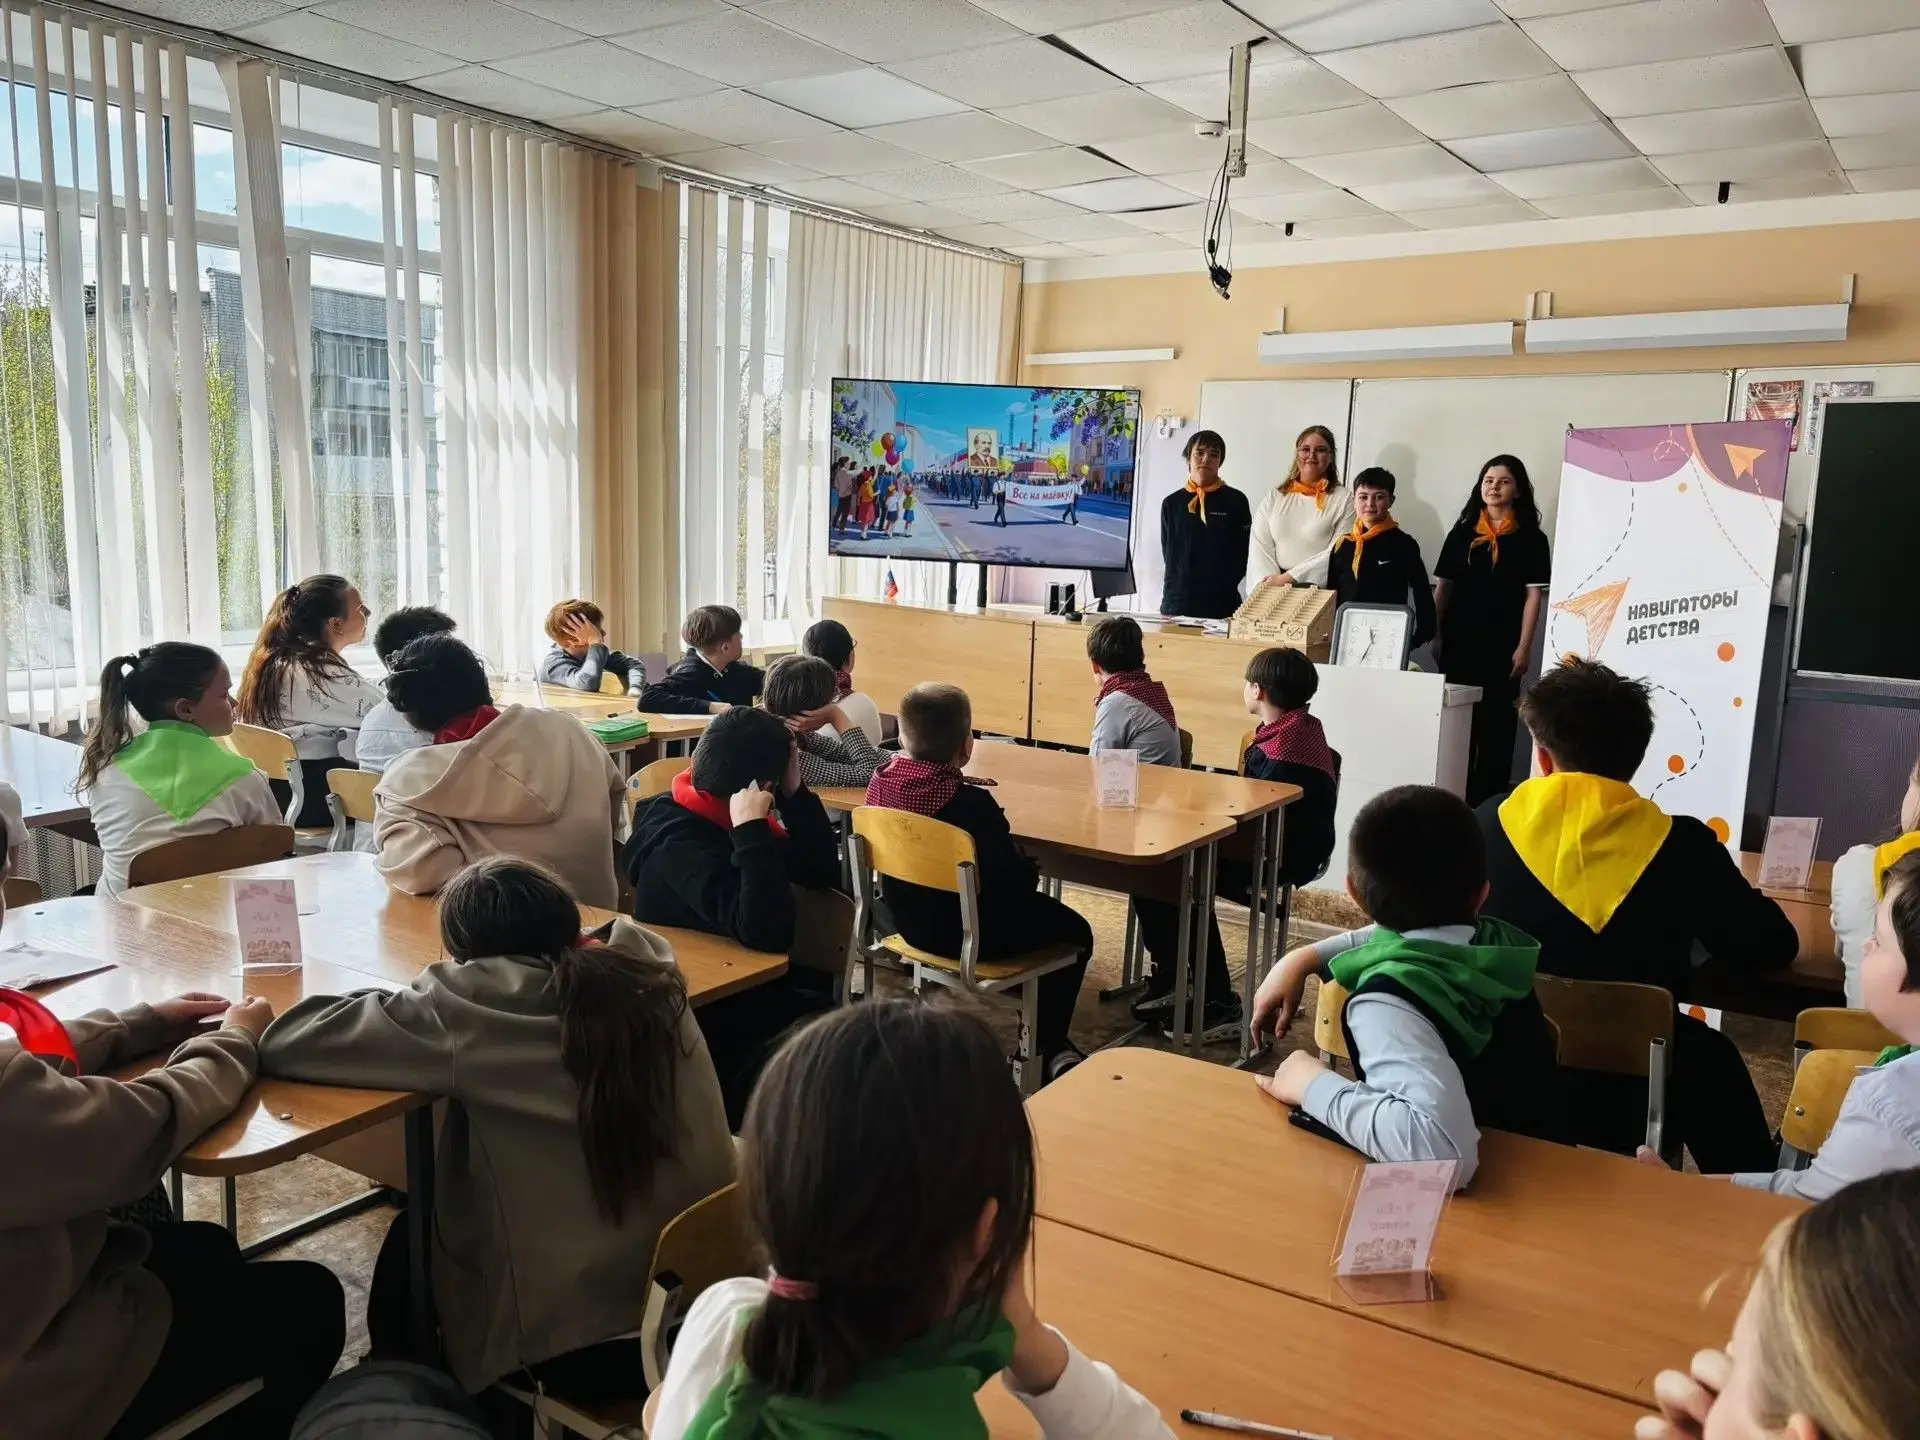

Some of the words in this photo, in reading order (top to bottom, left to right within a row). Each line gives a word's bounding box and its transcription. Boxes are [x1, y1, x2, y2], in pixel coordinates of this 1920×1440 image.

[1013, 487, 1028, 500] Все
[1030, 492, 1040, 501] на
[1627, 590, 1738, 620] НАВИГАТОРЫ
[1626, 618, 1700, 645] ДЕТСТВА
